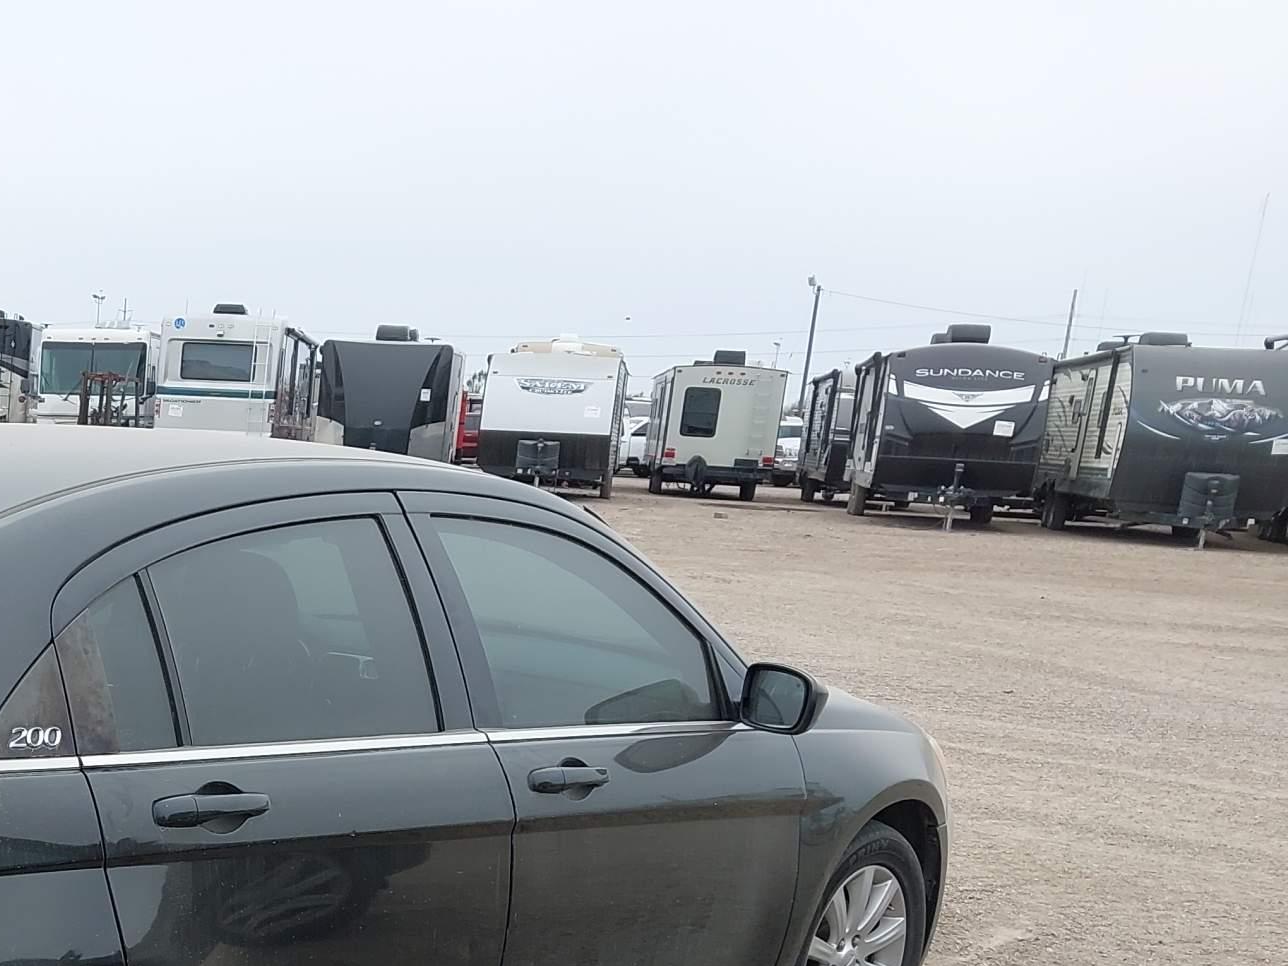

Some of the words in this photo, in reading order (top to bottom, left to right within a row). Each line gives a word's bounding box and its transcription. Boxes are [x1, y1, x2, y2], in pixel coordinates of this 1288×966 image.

[702, 376, 757, 387] LACROSSE
[915, 367, 1025, 381] SUNDANCE
[1175, 375, 1266, 396] PUMA
[8, 726, 62, 748] 200
